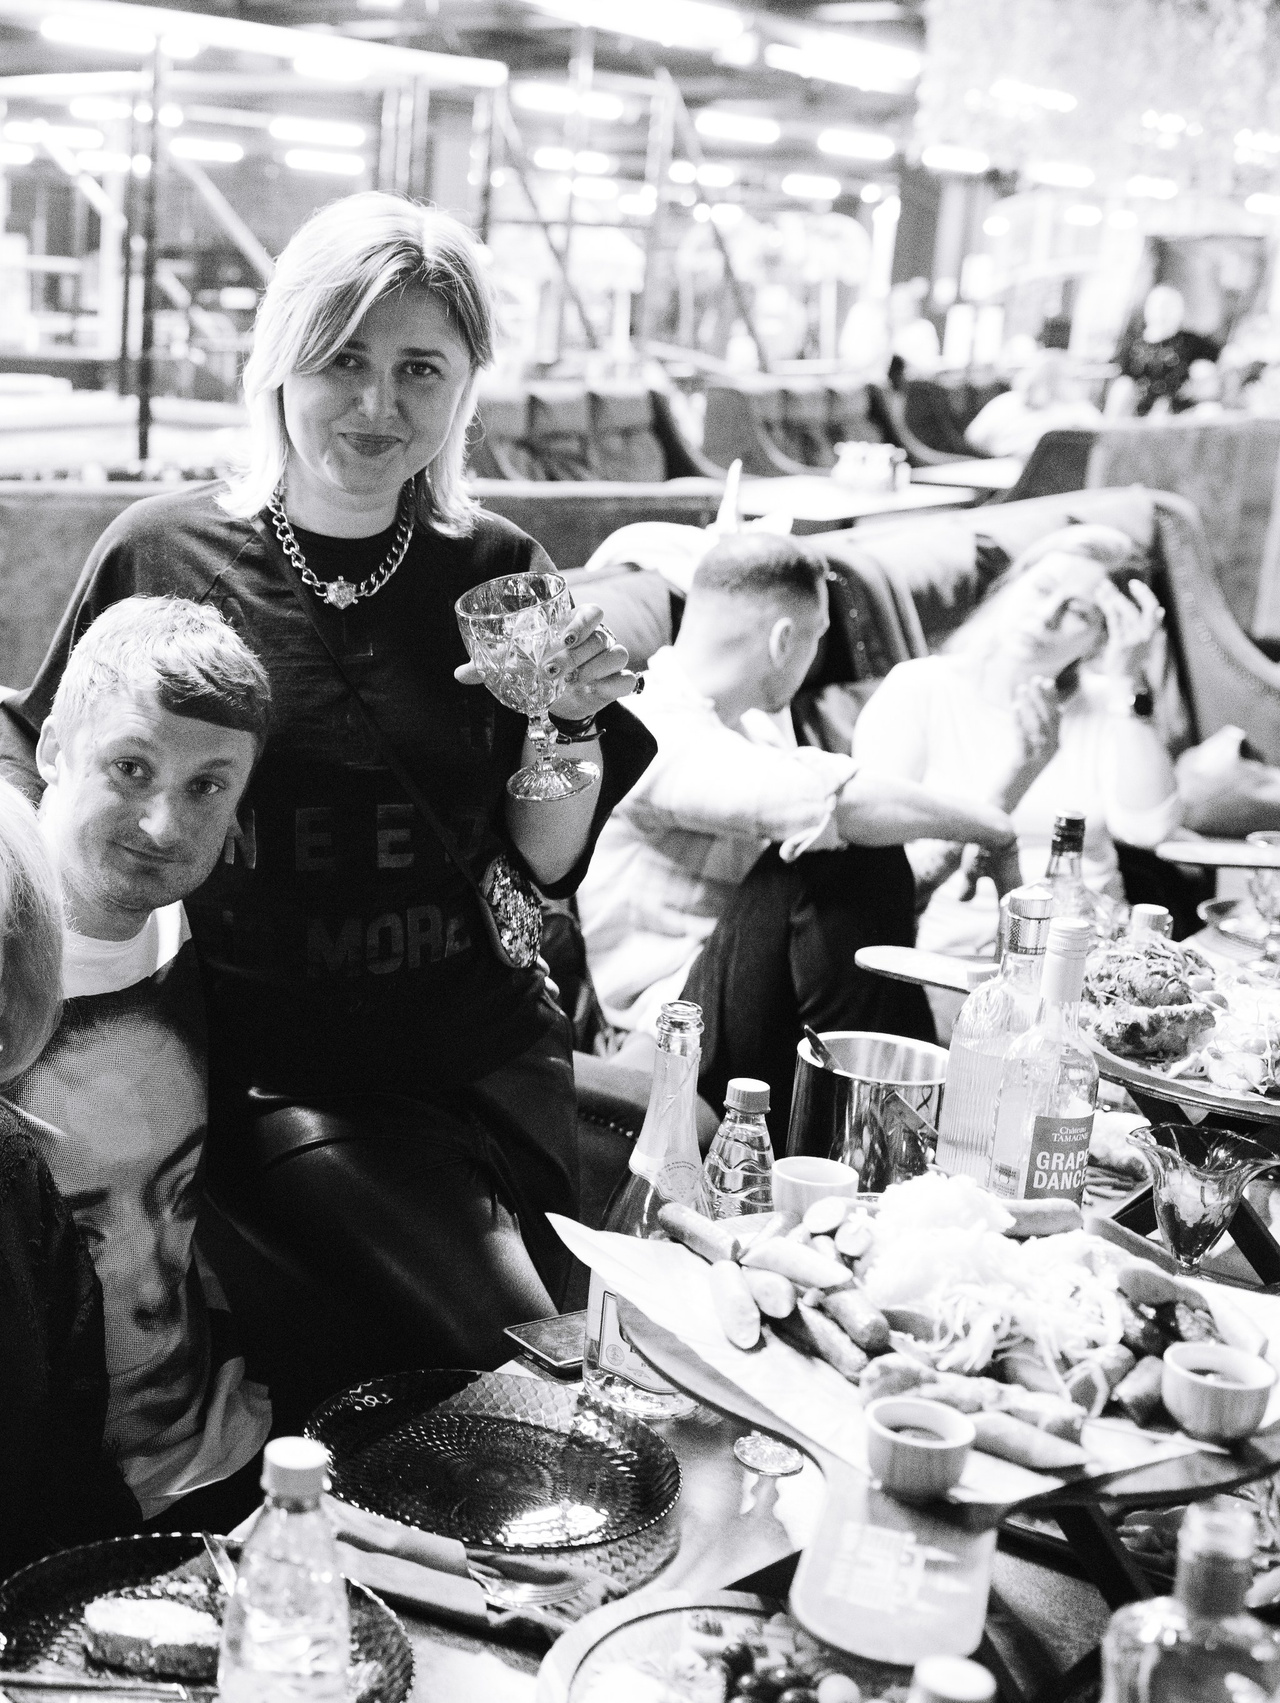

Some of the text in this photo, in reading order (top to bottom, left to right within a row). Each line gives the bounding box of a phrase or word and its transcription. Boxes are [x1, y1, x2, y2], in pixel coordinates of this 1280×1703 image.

[306, 904, 472, 978] MORE
[1036, 1148, 1090, 1171] GRAPE
[1033, 1168, 1088, 1190] DANCE
